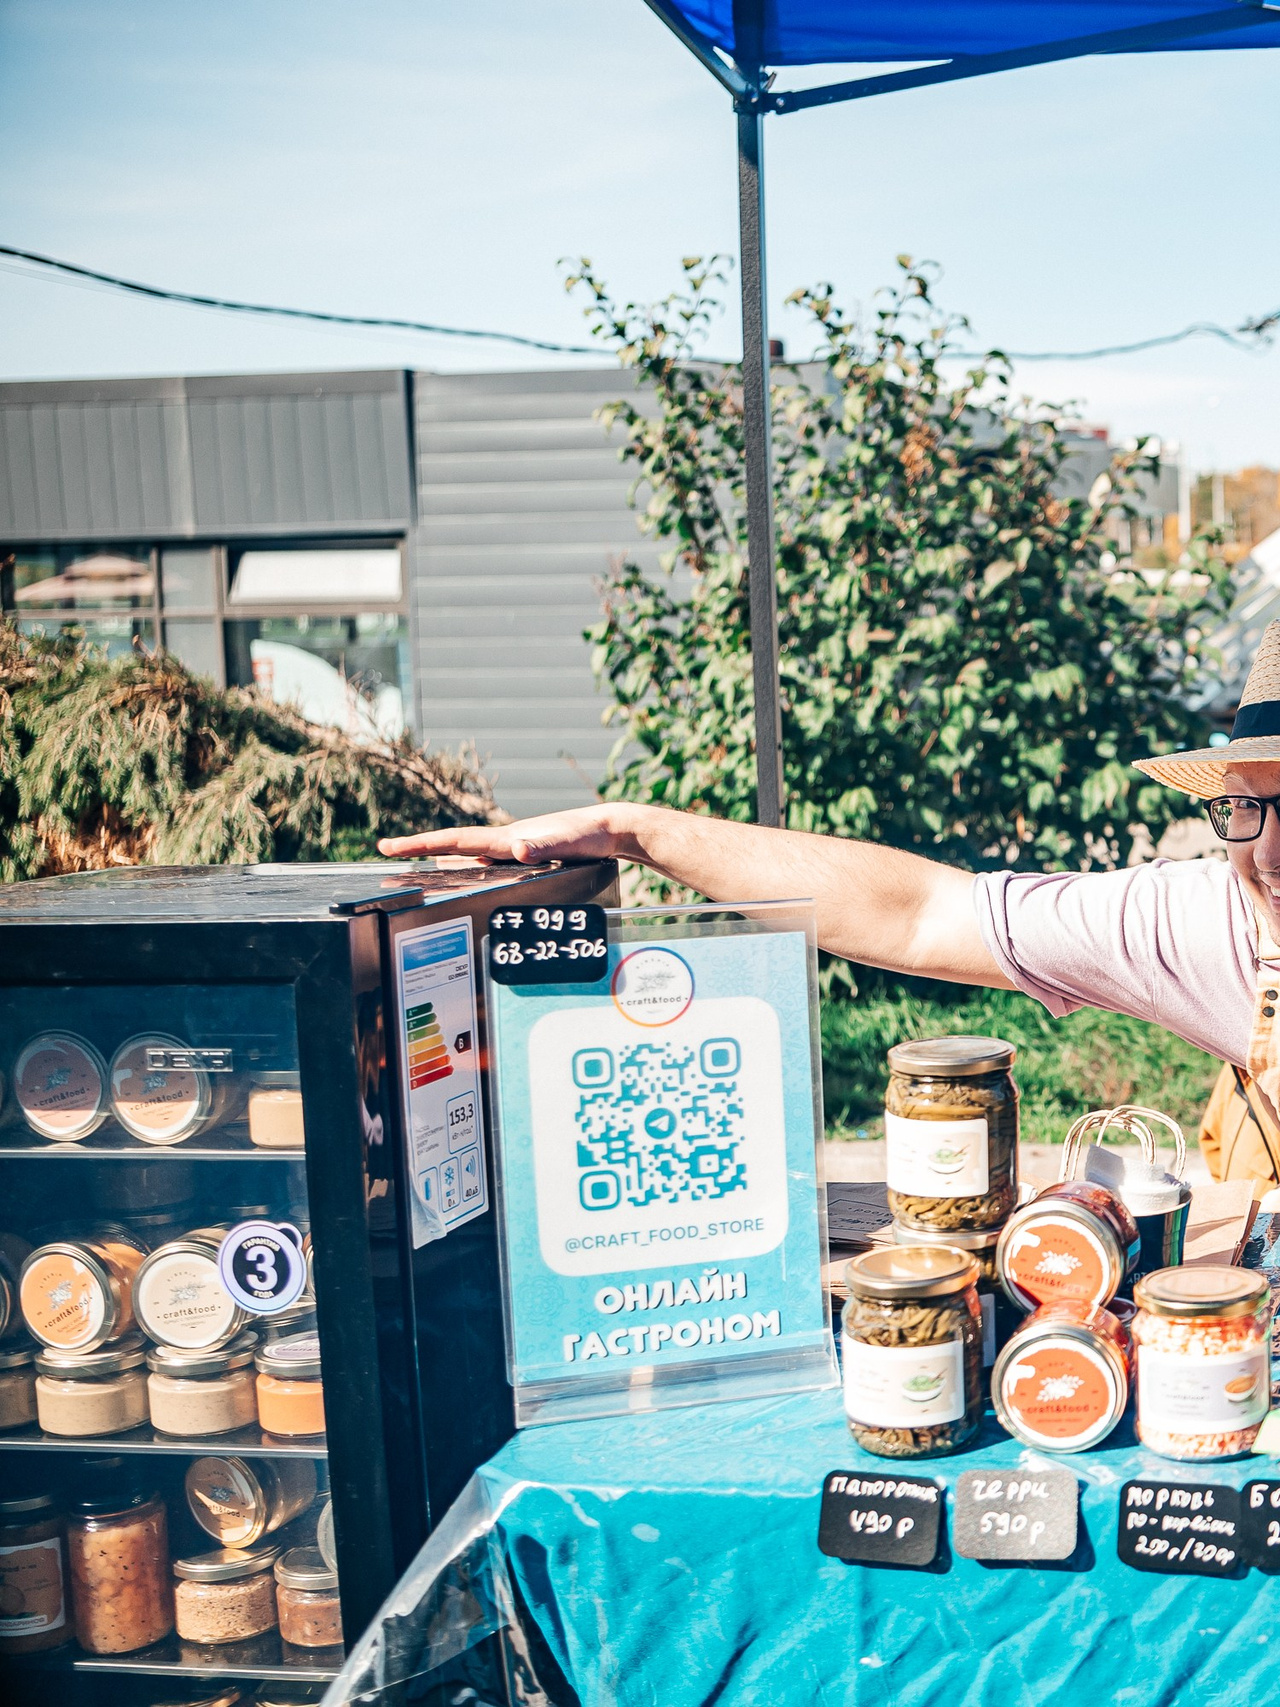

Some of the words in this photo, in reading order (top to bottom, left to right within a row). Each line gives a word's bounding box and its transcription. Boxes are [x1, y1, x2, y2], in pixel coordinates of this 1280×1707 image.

[626, 995, 682, 1006] craft&food
[449, 1102, 474, 1127] 153,3
[565, 1217, 765, 1253] @CRAFT_FOOD_STORE
[246, 1245, 278, 1291] 3
[594, 1266, 748, 1315] ОНЛАЙН
[47, 1297, 90, 1328] craft&food
[163, 1304, 217, 1319] craft&food
[562, 1309, 782, 1362] ГАСТРОНОМ
[1026, 1404, 1090, 1413] craft&food
